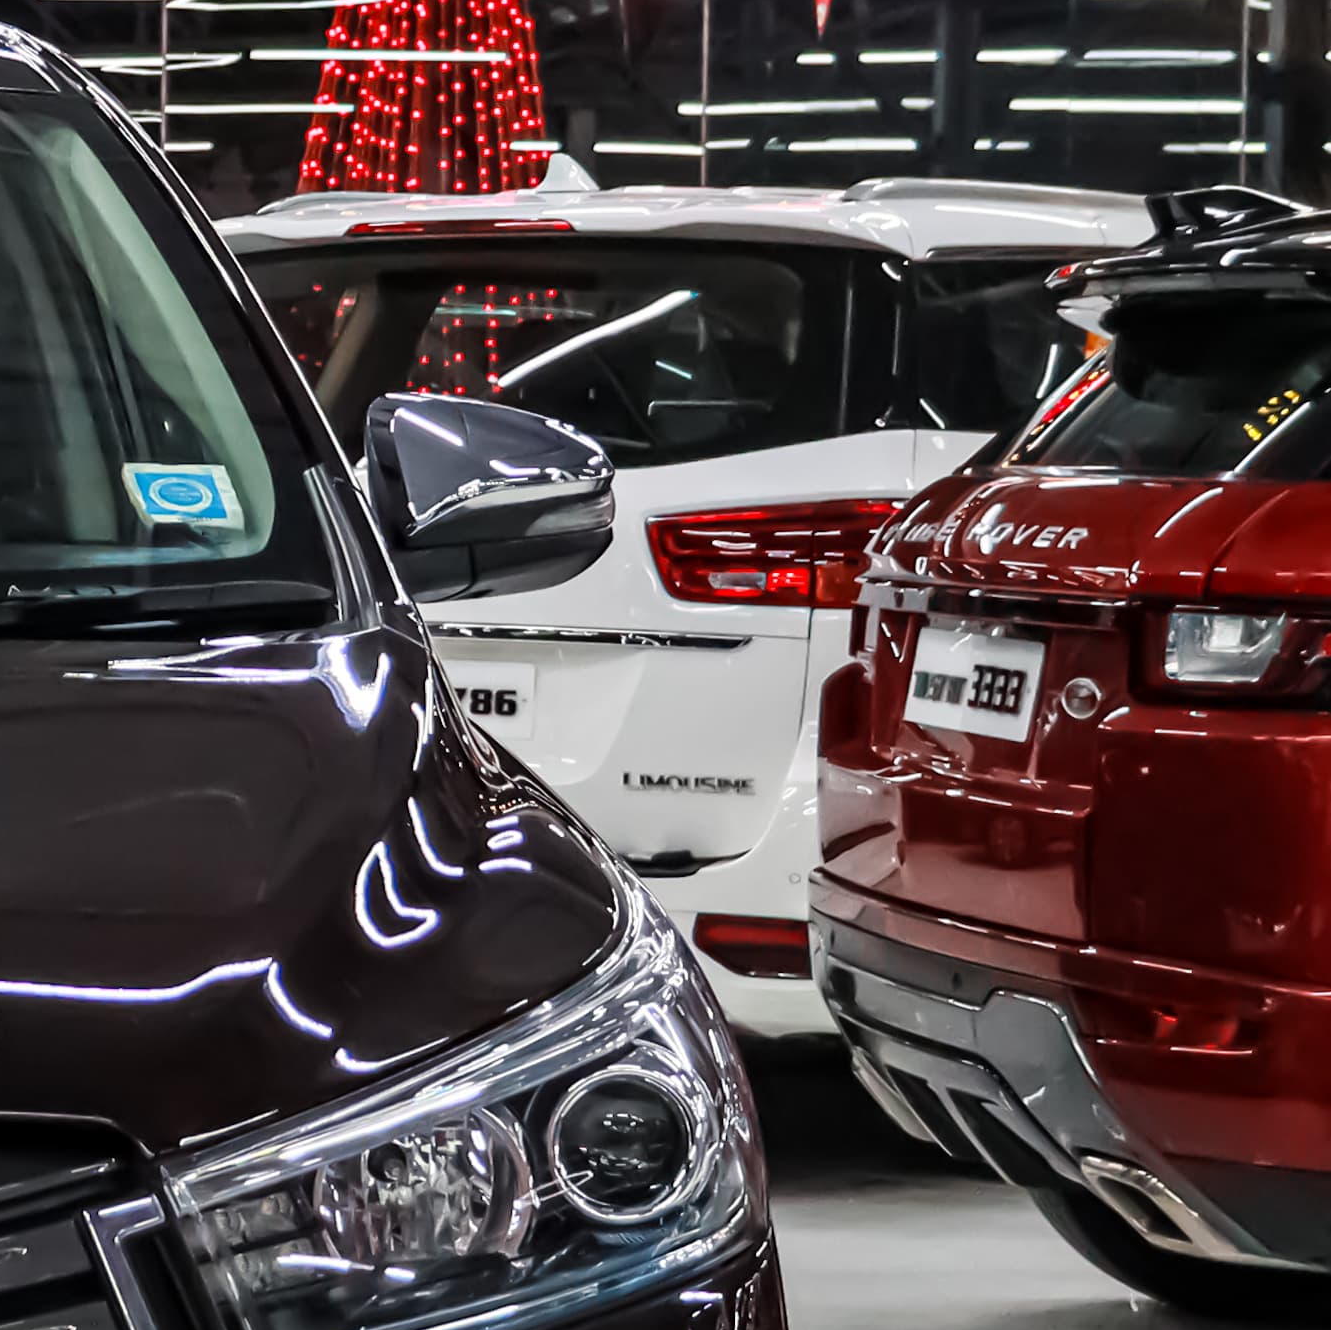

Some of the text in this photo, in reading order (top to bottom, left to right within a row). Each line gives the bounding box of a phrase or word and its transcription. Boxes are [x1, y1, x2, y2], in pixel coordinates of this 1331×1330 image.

[967, 522, 1090, 550] ROVER
[967, 664, 1028, 716] 3333
[622, 772, 756, 796] LIMOUSINE
